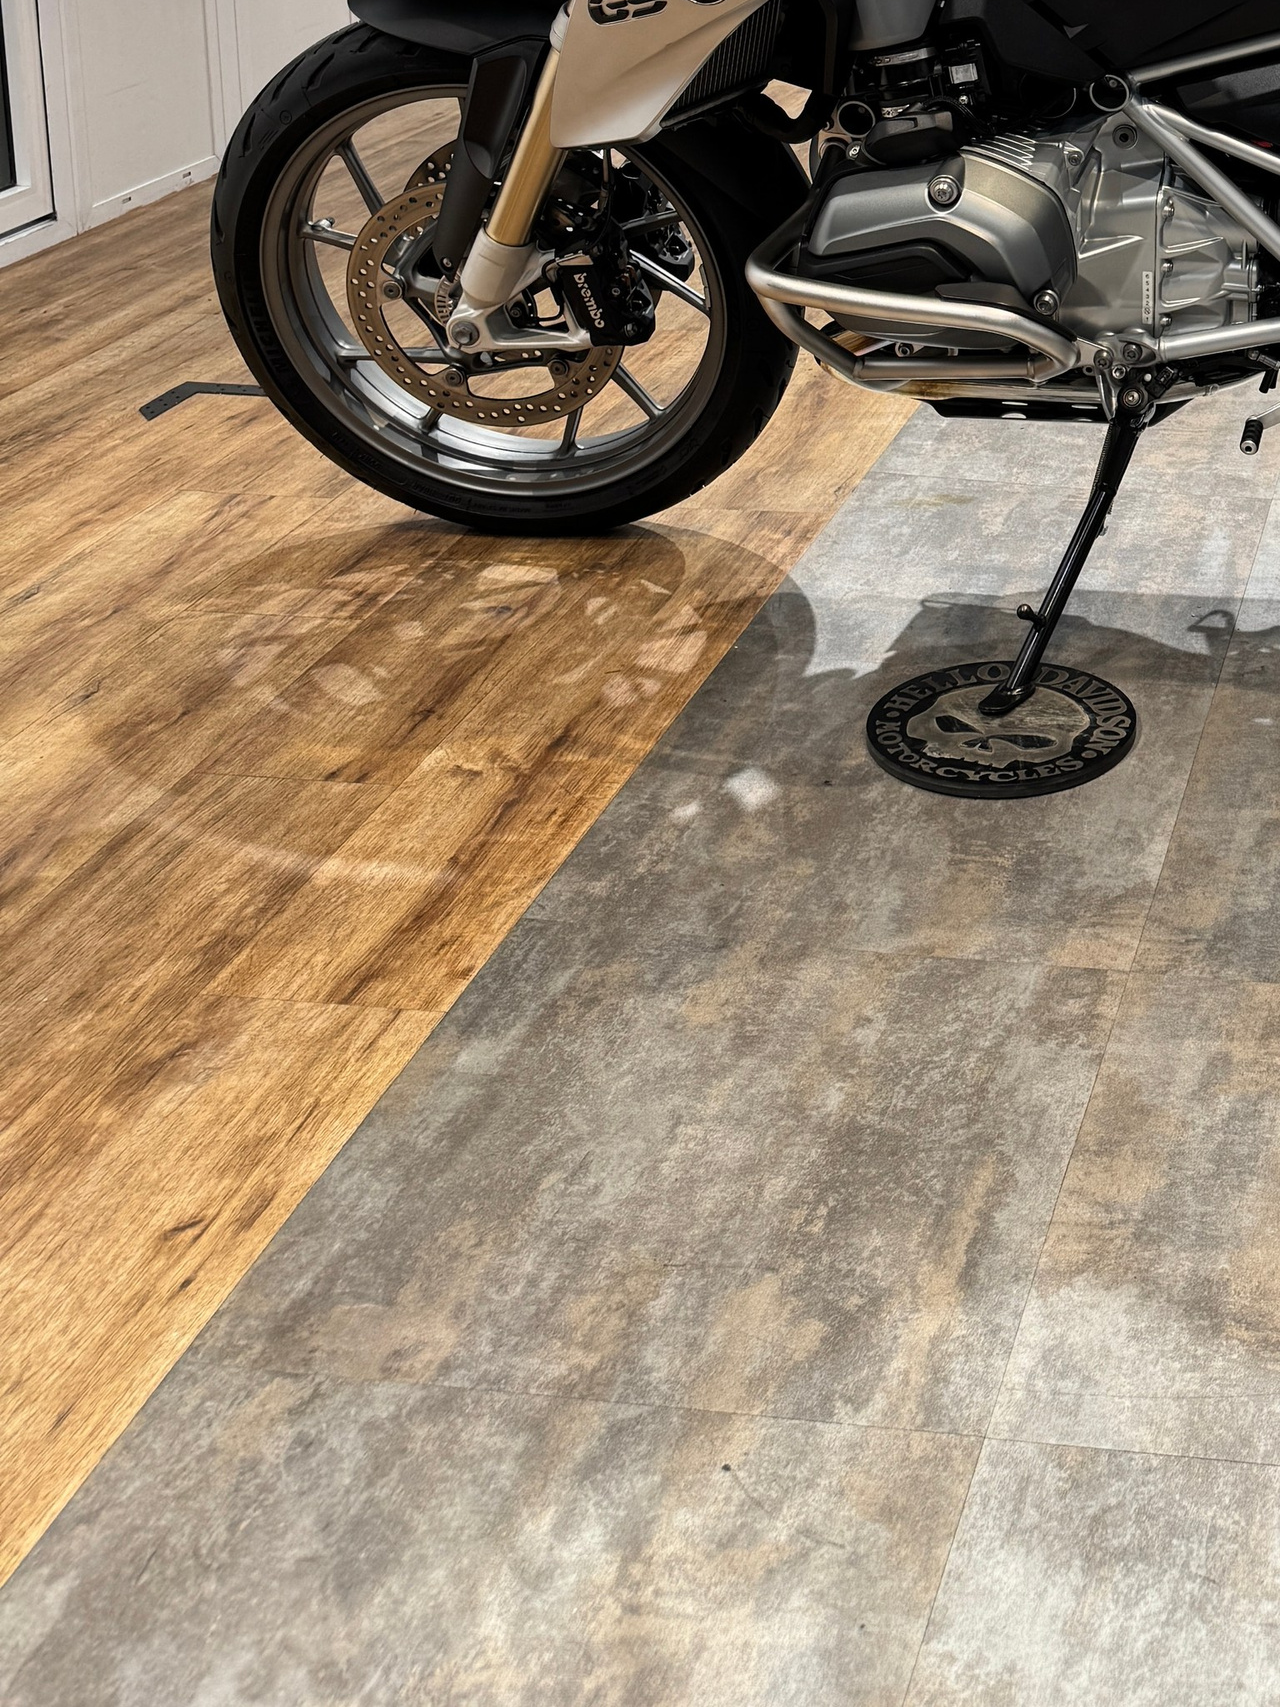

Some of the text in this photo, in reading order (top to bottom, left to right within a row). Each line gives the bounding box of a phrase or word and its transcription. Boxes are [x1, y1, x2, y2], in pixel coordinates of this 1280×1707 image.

[573, 272, 605, 329] brembo
[883, 663, 1132, 758] HELLO DAVIDSON
[875, 719, 1085, 783] MOTORCYCLES
